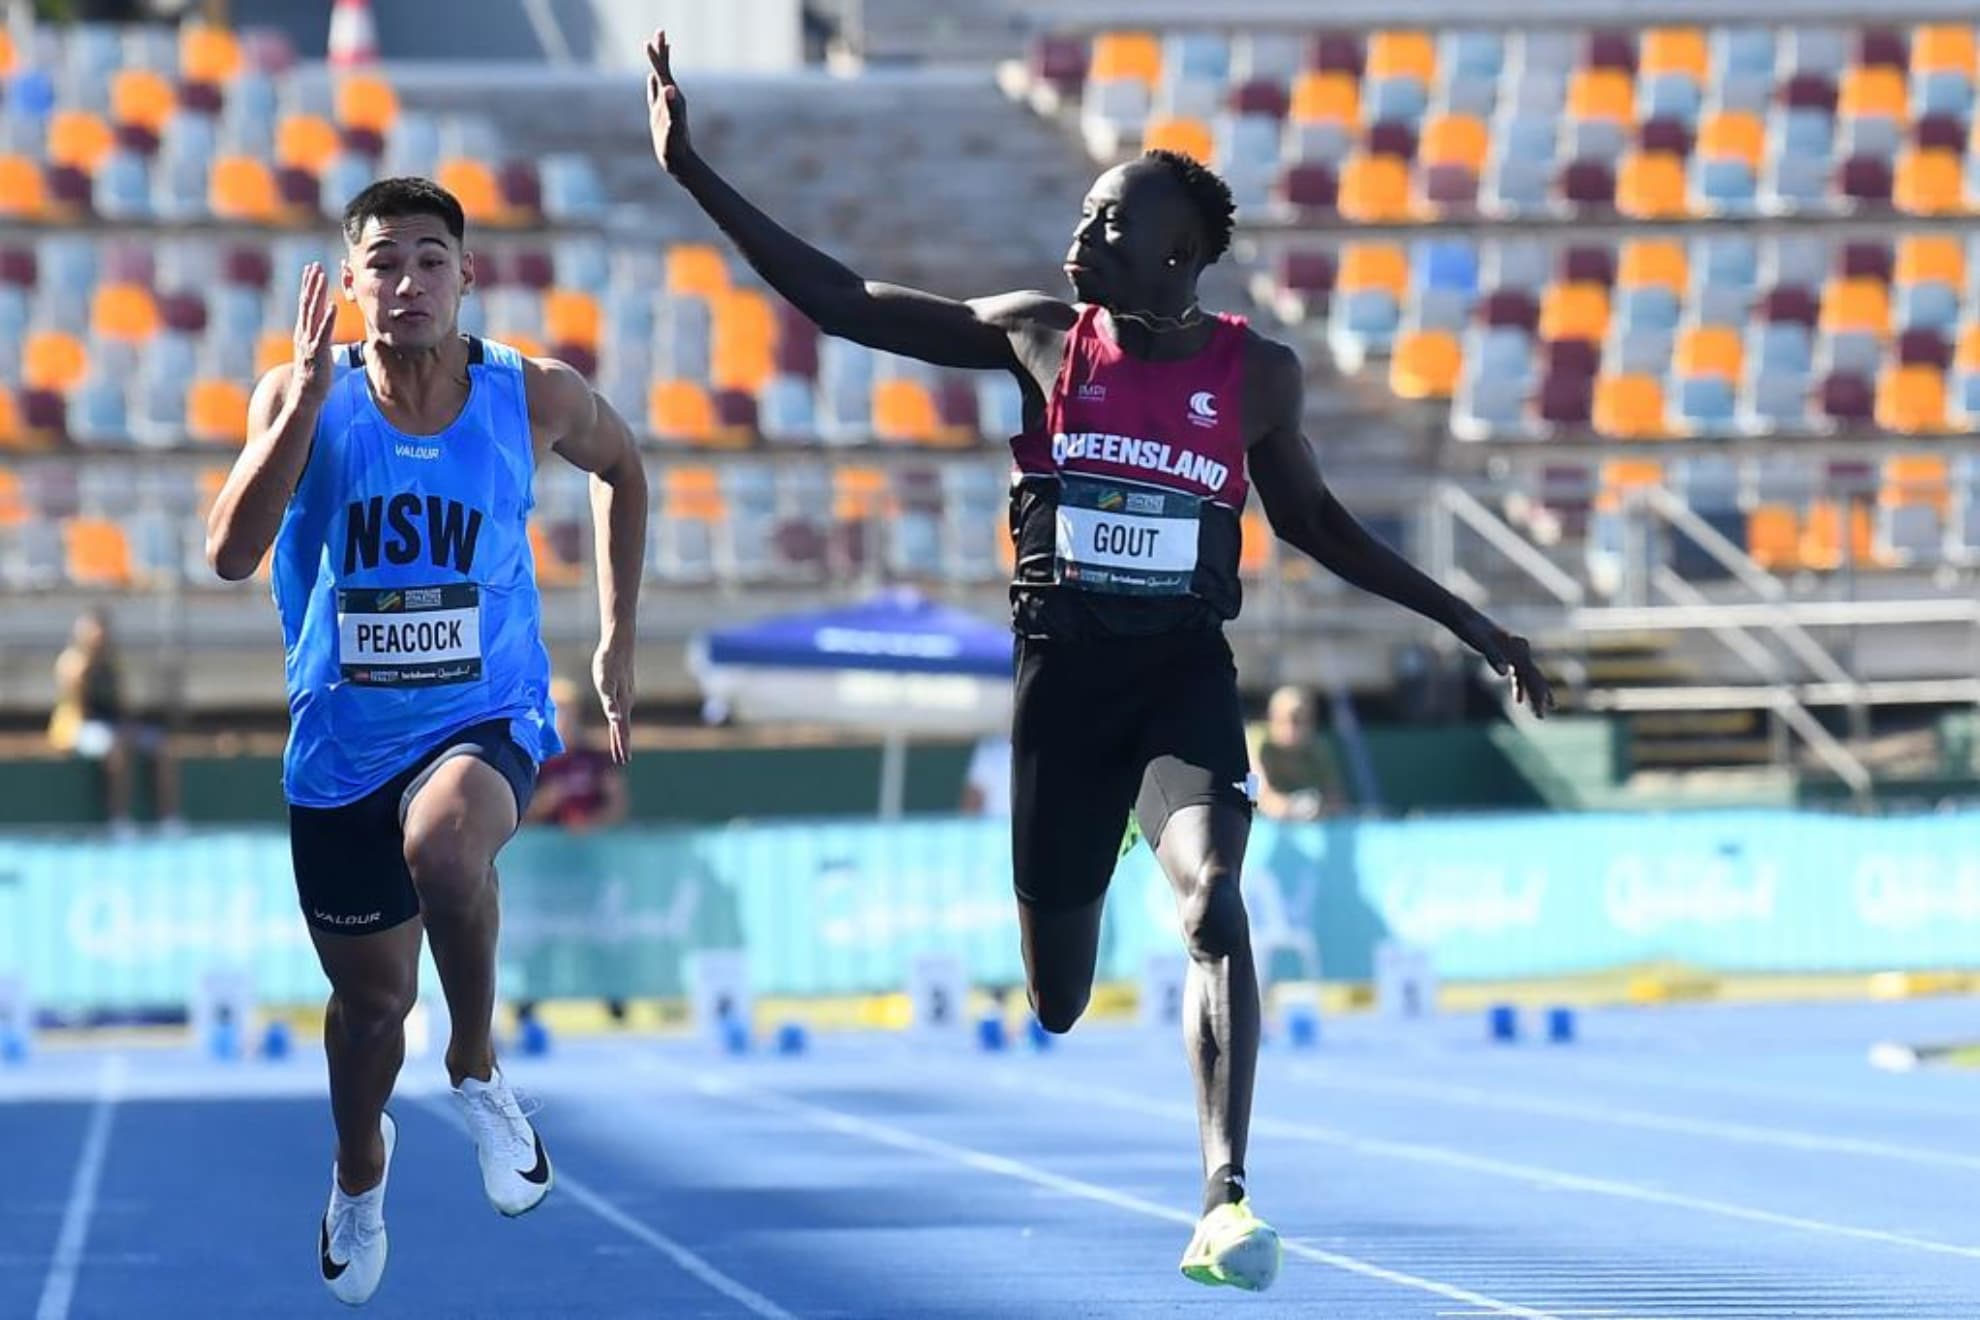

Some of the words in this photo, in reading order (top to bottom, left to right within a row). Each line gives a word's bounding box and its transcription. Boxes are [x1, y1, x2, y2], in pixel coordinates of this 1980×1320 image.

[395, 444, 440, 460] VALOUR
[1052, 432, 1229, 491] QUEENSLAND
[343, 493, 483, 577] NSW
[1094, 523, 1159, 558] GOUT
[357, 619, 463, 654] PEACOCK
